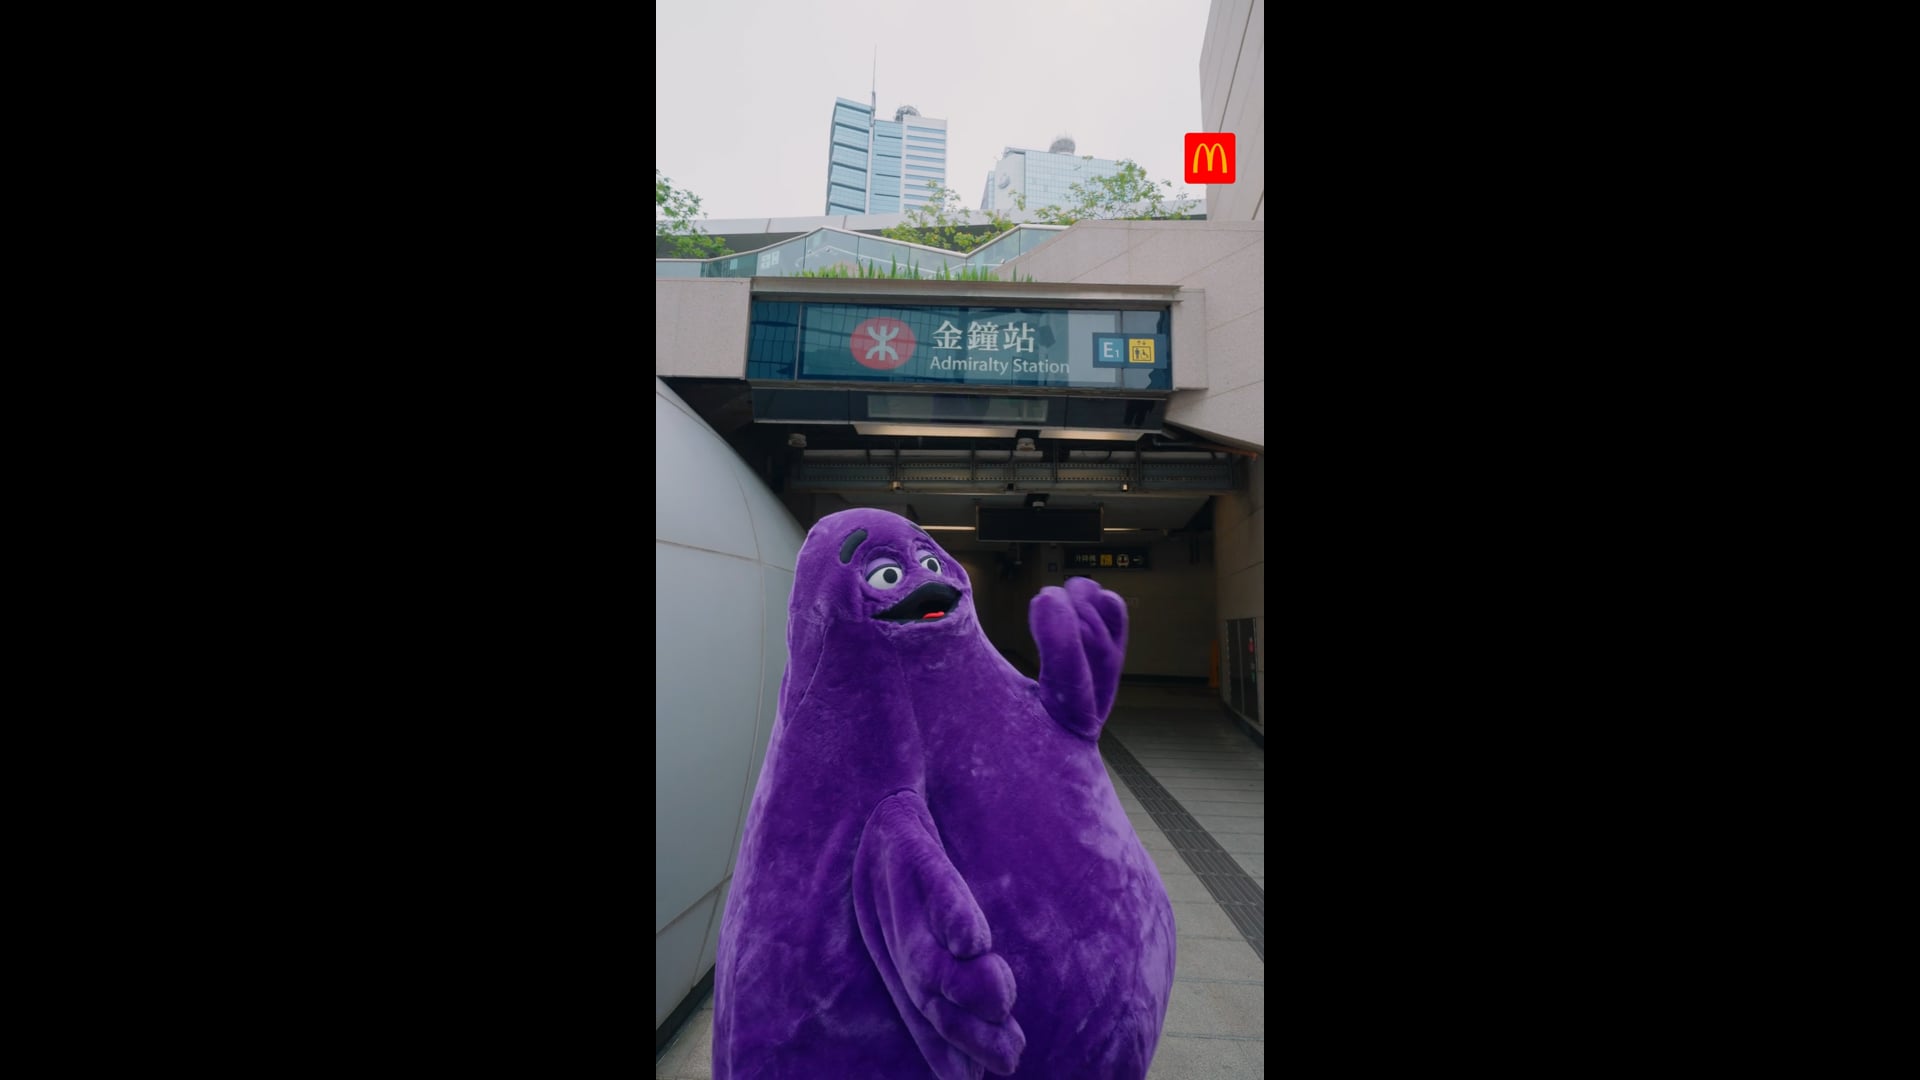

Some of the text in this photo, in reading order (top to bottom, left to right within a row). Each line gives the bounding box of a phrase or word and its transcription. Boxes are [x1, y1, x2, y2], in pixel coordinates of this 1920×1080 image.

[932, 319, 1036, 353] 金鐘站
[930, 355, 1071, 375] Admiralty Station
